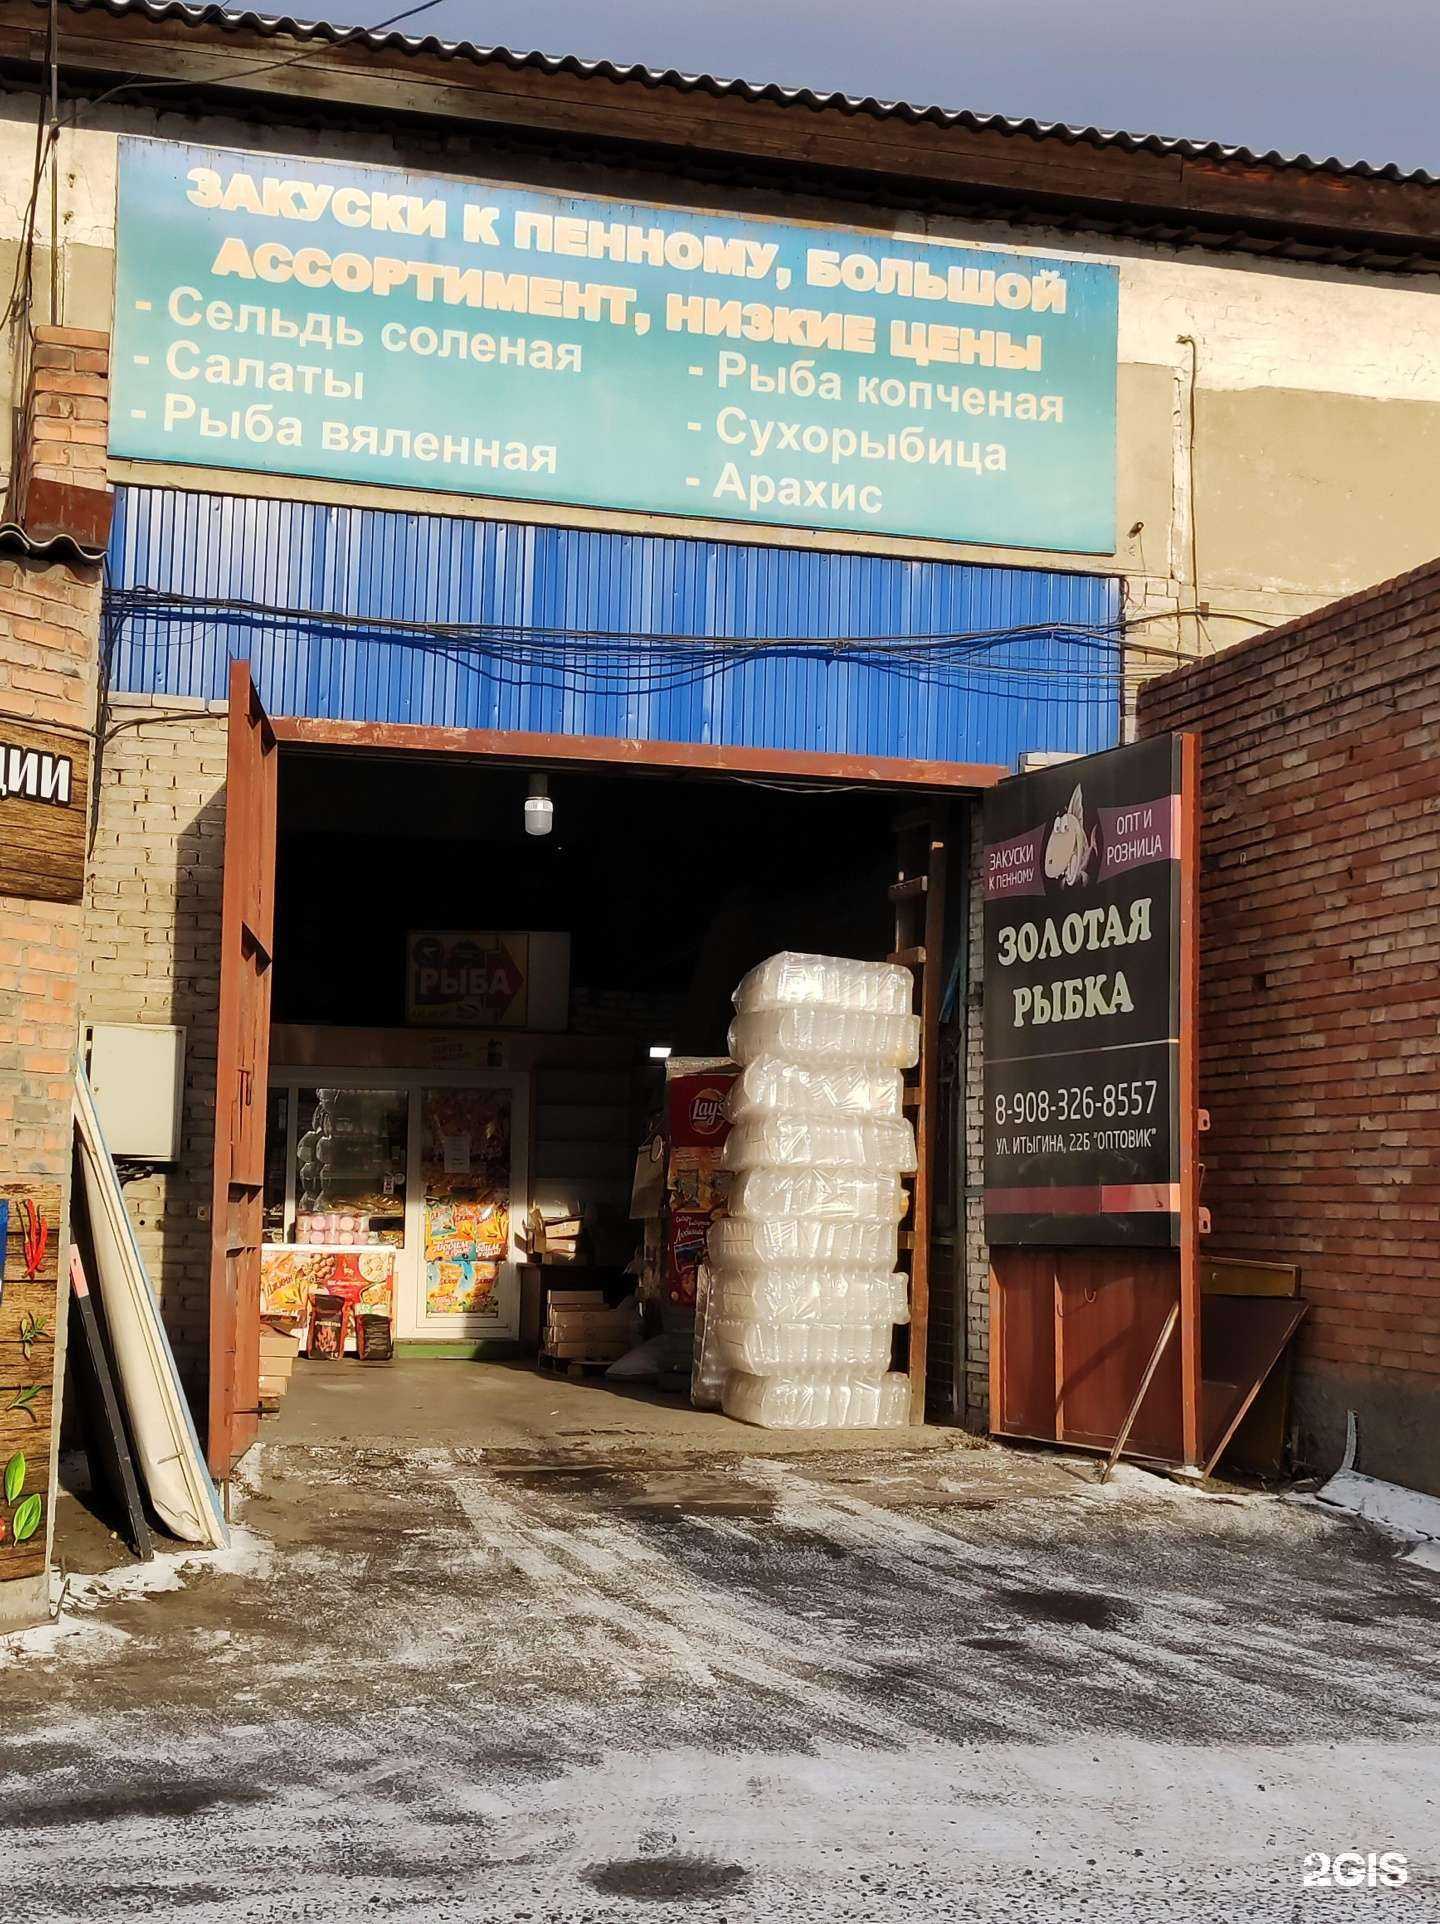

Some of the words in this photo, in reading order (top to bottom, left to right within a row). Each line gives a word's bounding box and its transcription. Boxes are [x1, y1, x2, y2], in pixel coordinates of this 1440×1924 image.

[186, 167, 446, 238] ЗАКУСКИ
[463, 204, 500, 246] К
[514, 210, 791, 290] ПЕННОМУ,
[807, 248, 1067, 314] БОЛЬШОЙ
[168, 286, 364, 349] Сельдь
[381, 322, 582, 372] соленая
[211, 238, 650, 336] АССОРТИМЕНТ,
[667, 293, 876, 354] НИЗКИЕ
[890, 320, 1042, 371] ЦЕНЫ
[166, 340, 363, 400] Салаты
[718, 351, 842, 401] Рыба
[858, 376, 1064, 423] копченая
[163, 393, 302, 446] Рыба
[322, 420, 557, 474] вяленная
[716, 407, 1006, 475] Сухорыбица
[713, 463, 882, 513] Арахис
[1106, 834, 1162, 866] РОЗНИЦА
[1116, 811, 1142, 835] ОПТ
[988, 877, 996, 891] К
[996, 868, 1035, 889] ПЕННОМУ
[989, 844, 1034, 871] ЗАКУСКИ
[998, 897, 1153, 966] ЗОЛОТАЯ
[419, 967, 513, 997] РЫБА
[1012, 971, 1135, 1028] РЫБКА
[995, 1080, 1157, 1125] 8-908-326-8557
[996, 1137, 1011, 1156] УЛ.
